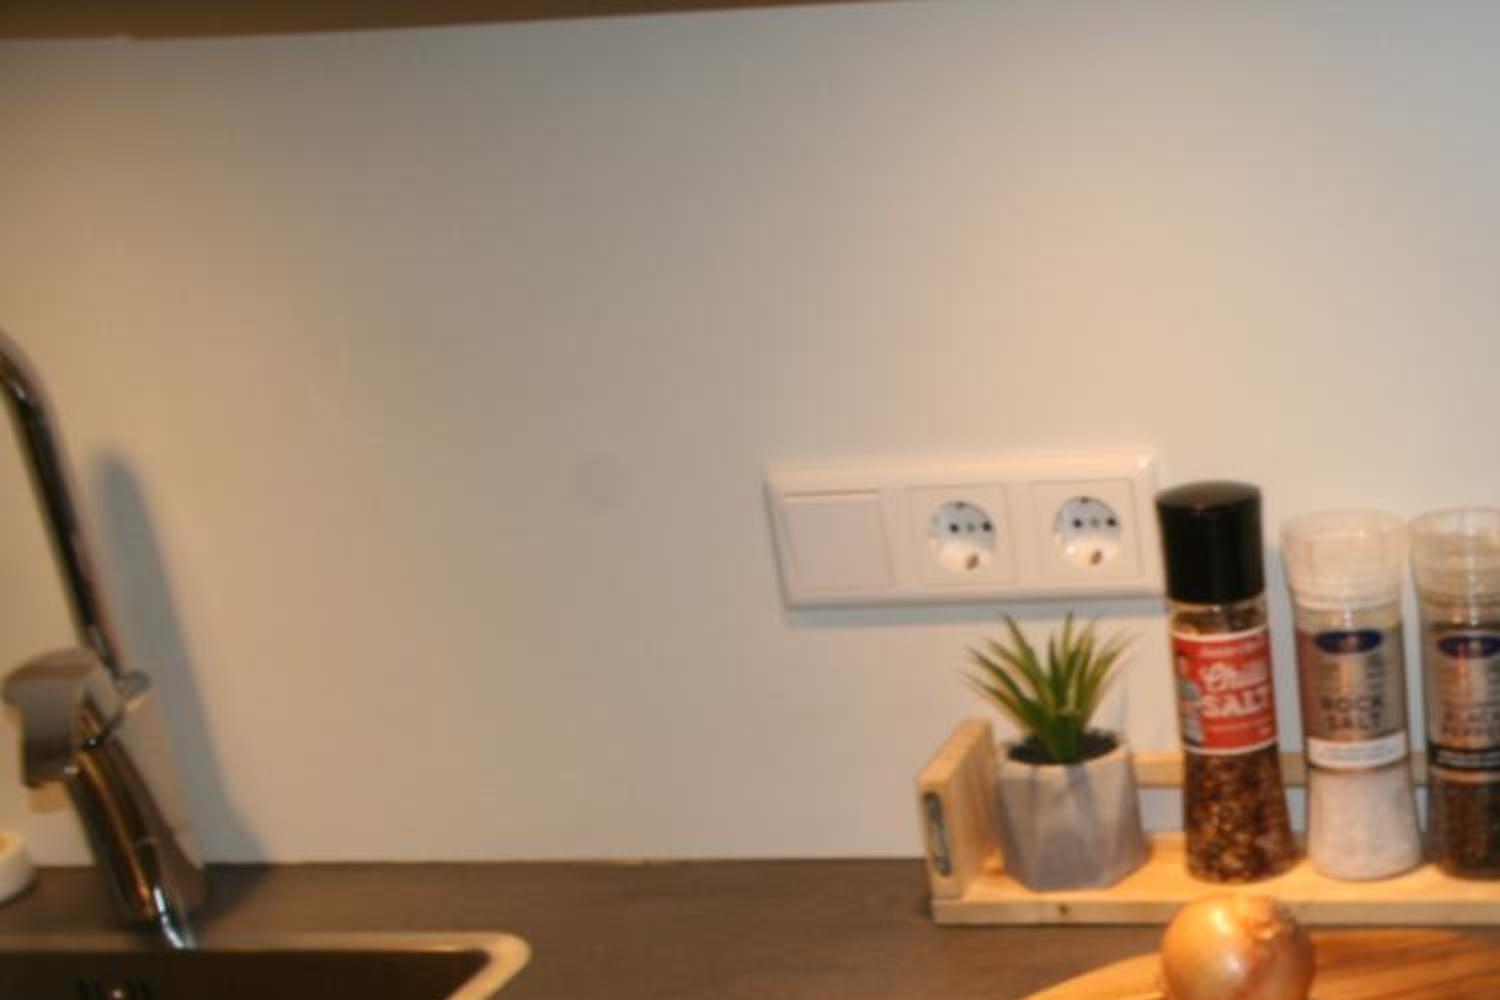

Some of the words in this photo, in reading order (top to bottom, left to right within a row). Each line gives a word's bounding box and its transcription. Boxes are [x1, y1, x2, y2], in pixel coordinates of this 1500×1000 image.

[1200, 688, 1272, 718] SALT
[1319, 695, 1384, 713] ROCK
[1325, 711, 1383, 731] SALT
